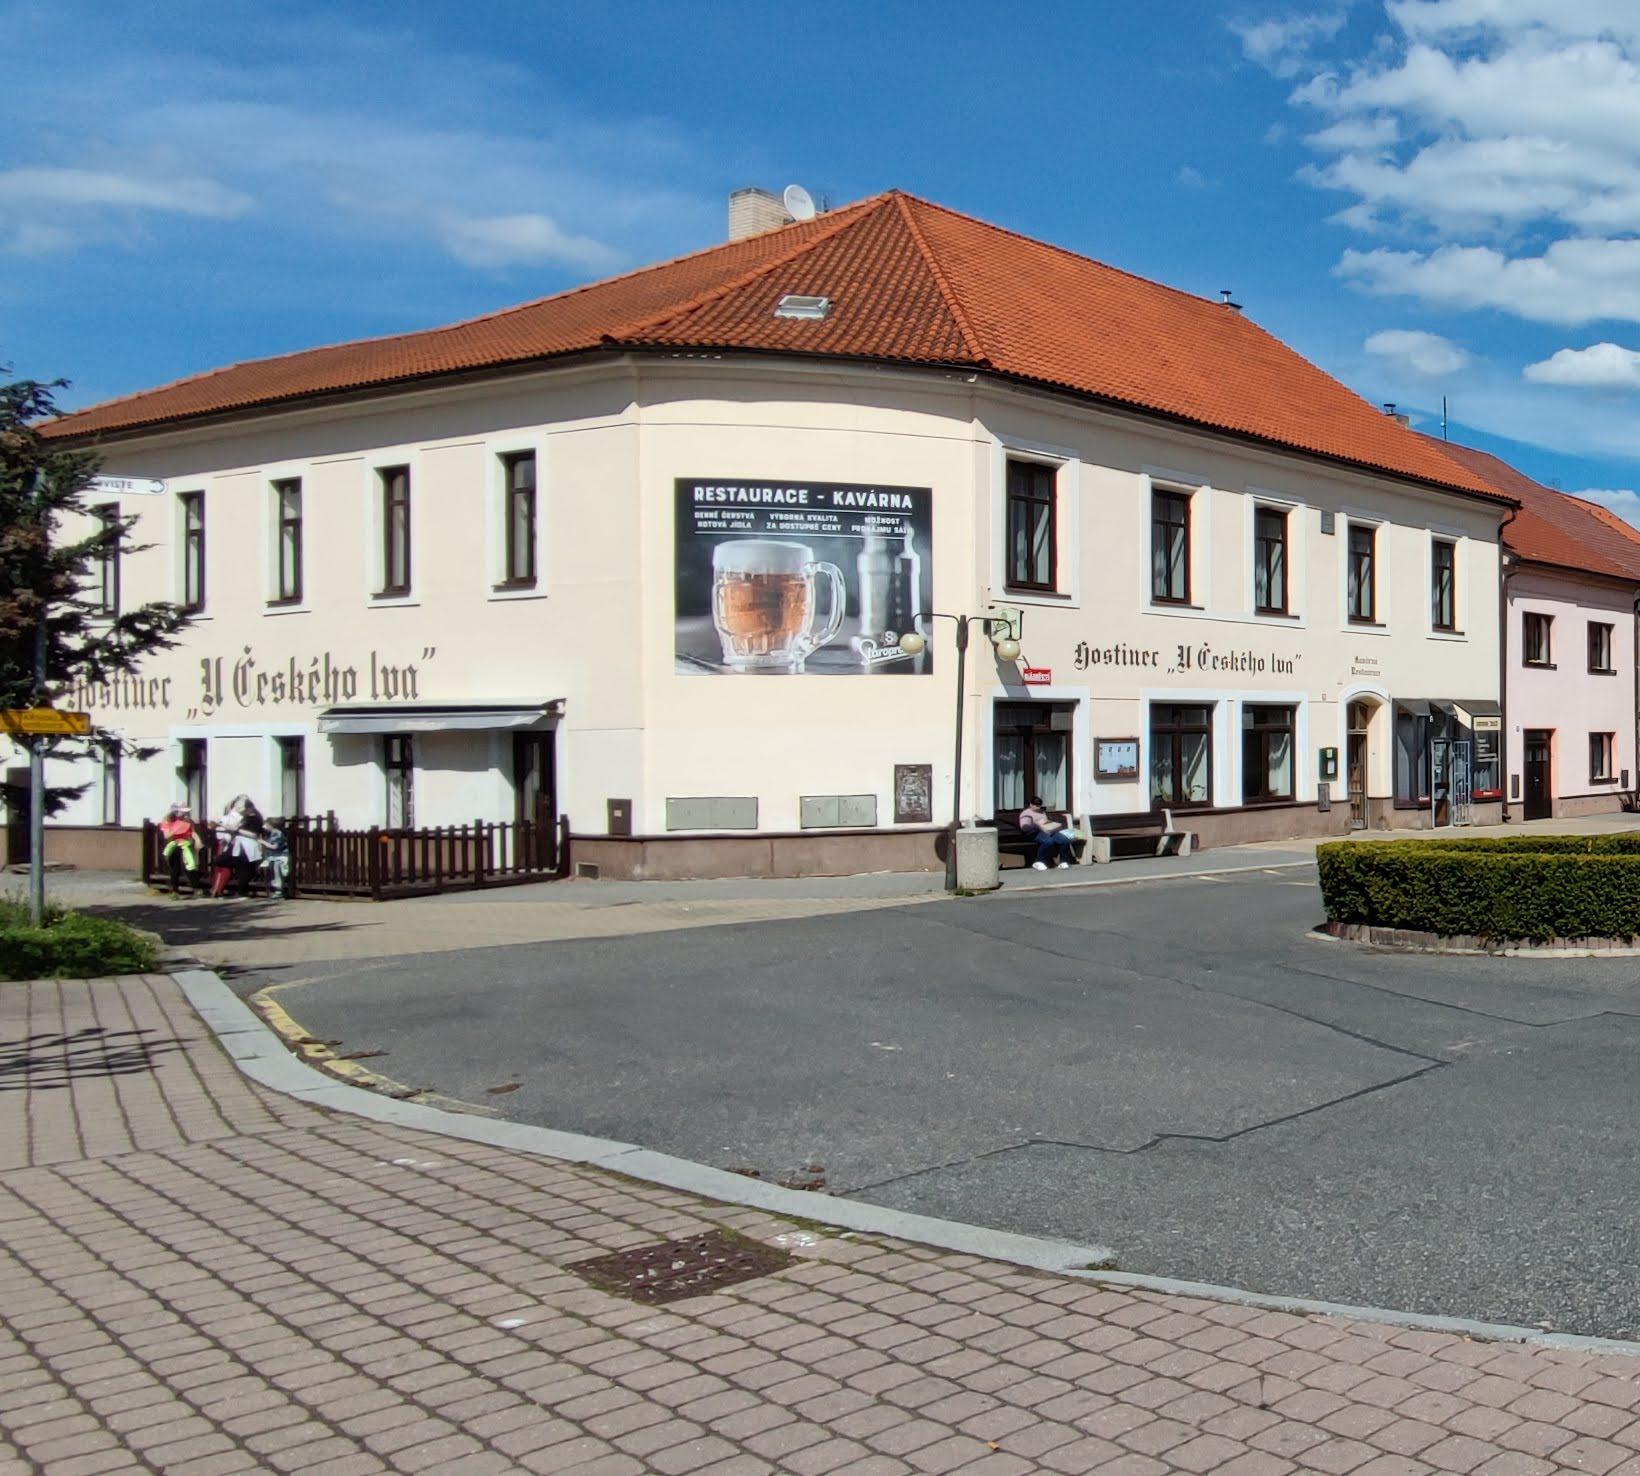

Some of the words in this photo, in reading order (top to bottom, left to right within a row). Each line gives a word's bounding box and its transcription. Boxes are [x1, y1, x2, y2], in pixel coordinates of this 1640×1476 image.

[694, 486, 808, 504] RESTAURACE
[833, 489, 912, 508] KAVÁRNA
[766, 521, 776, 529] ZA
[1073, 641, 1160, 671] Hostinec
[1198, 642, 1265, 677] Českého
[233, 645, 358, 708] Českého
